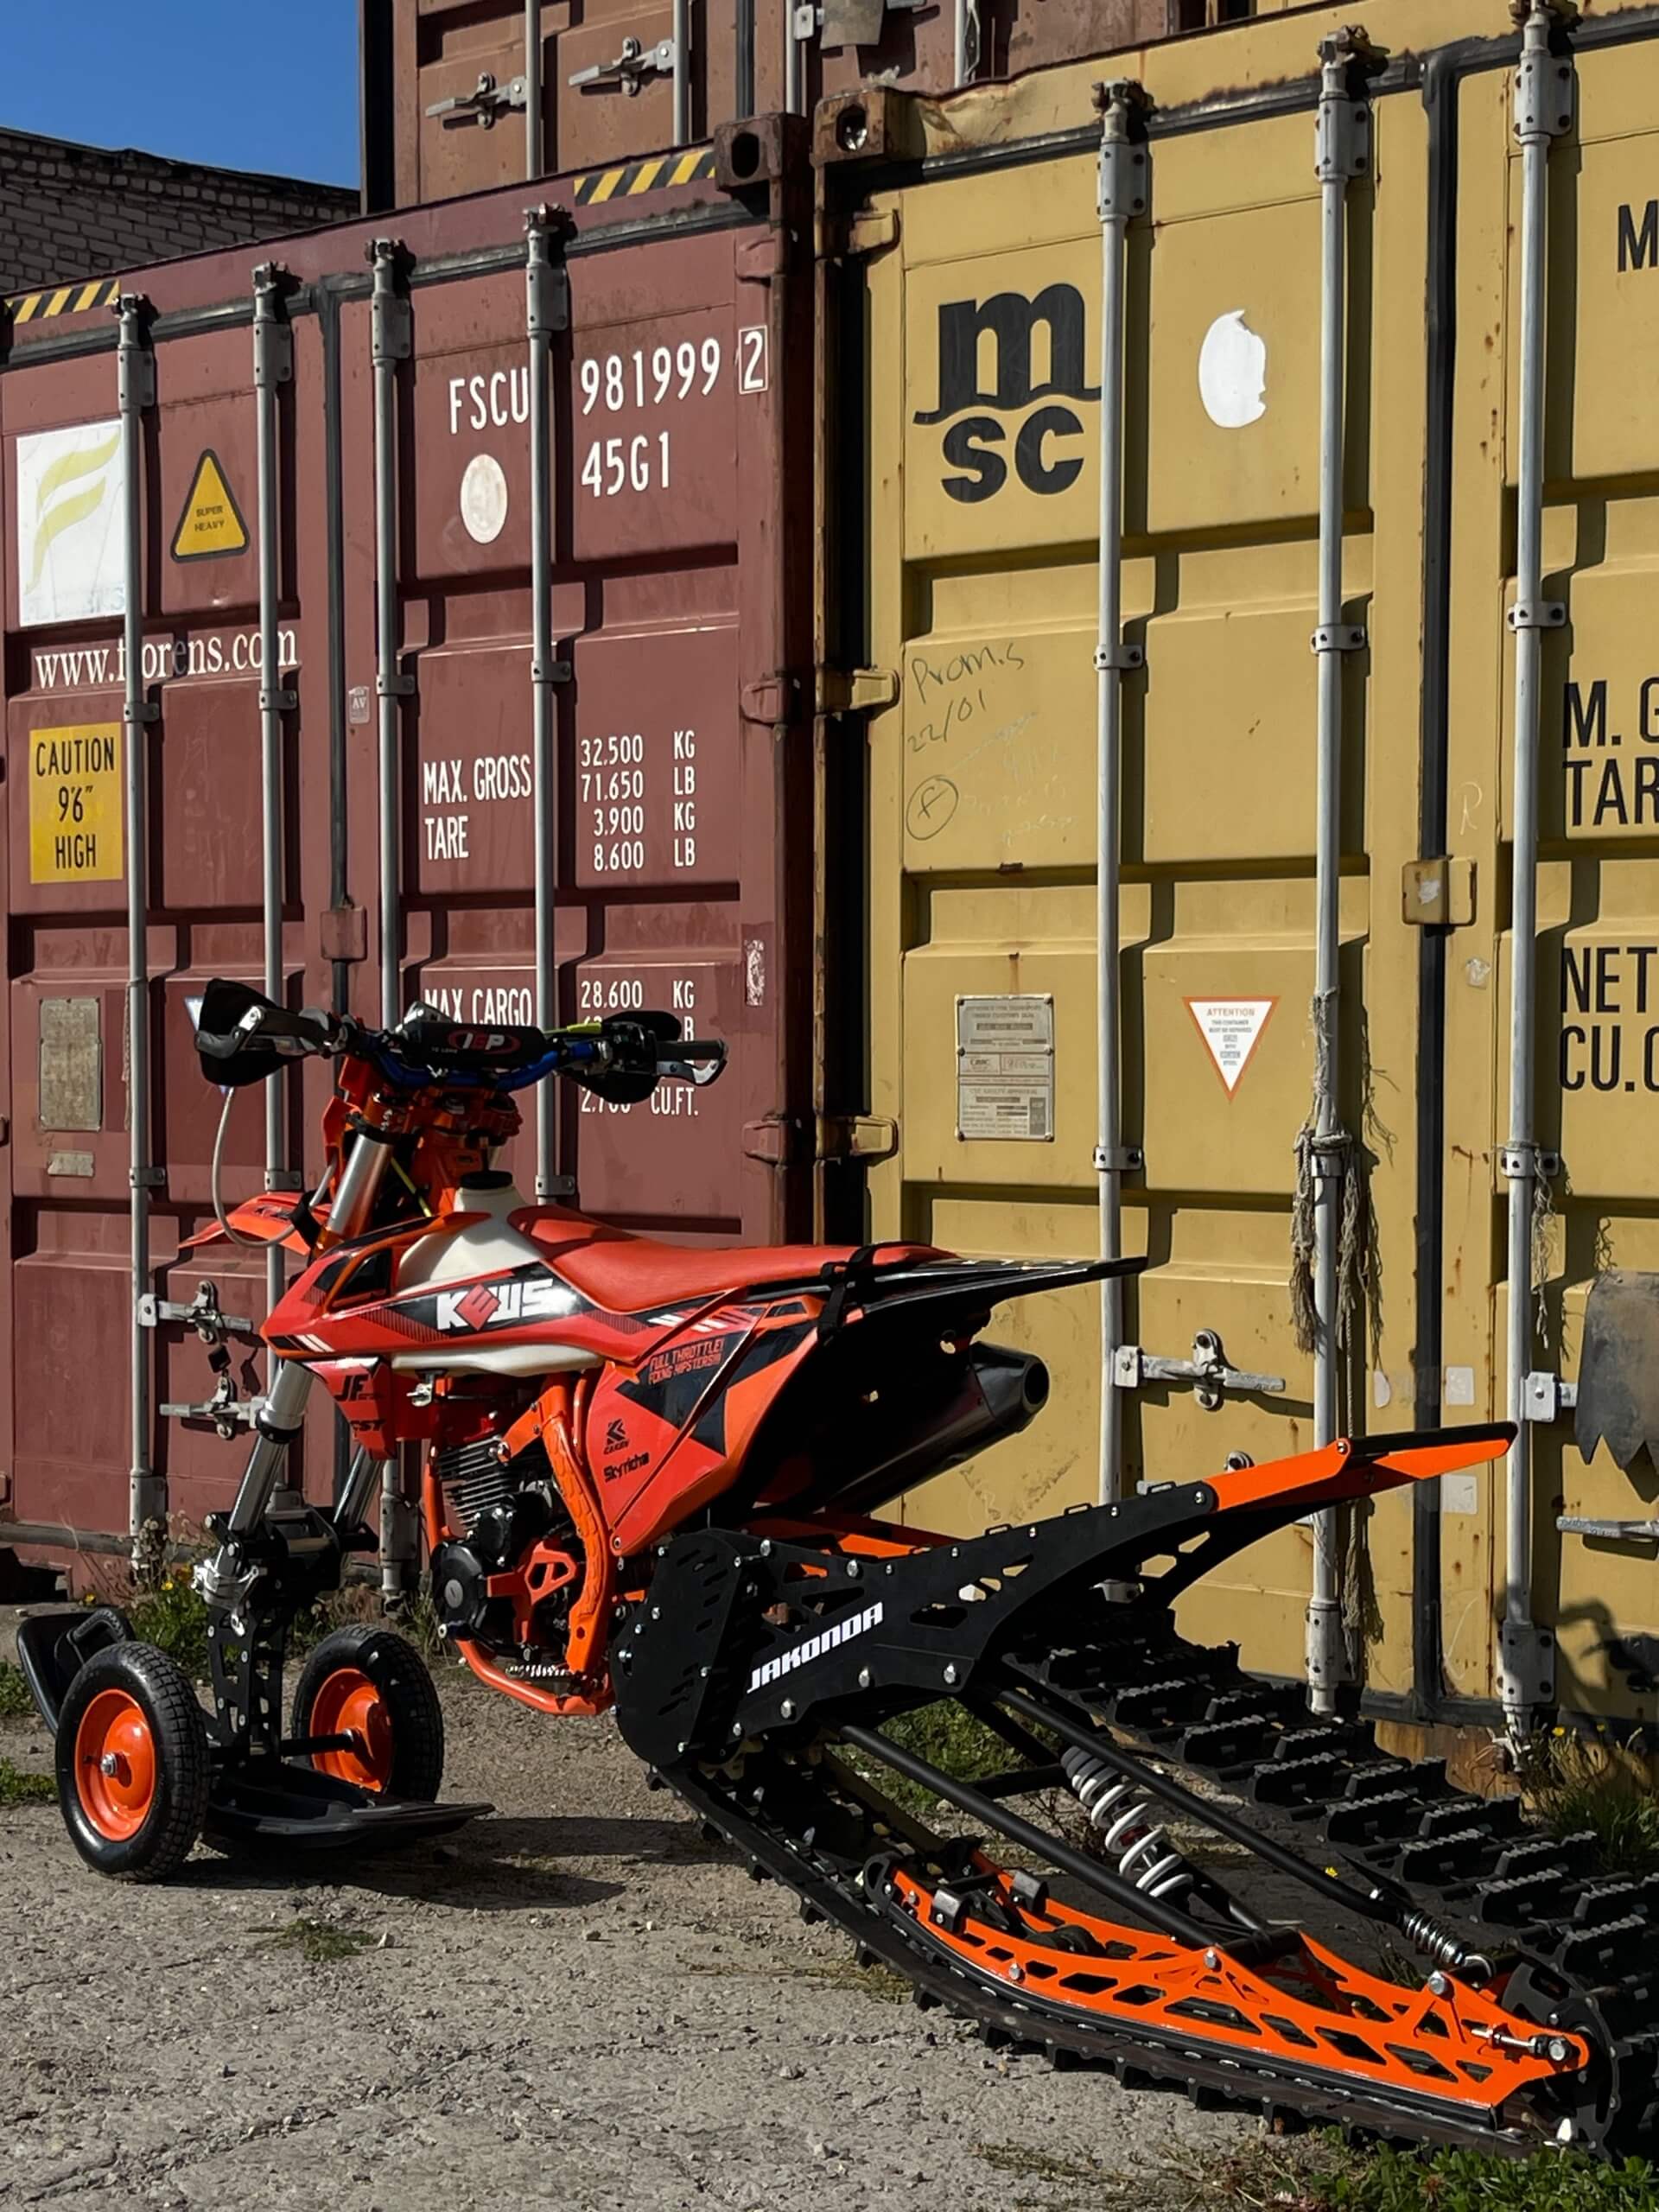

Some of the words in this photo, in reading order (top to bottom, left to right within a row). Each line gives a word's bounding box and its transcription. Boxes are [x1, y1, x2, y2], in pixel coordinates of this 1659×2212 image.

[1617, 199, 1658, 273] M
[448, 366, 530, 435] FSCU
[580, 338, 721, 416] 981999
[742, 329, 766, 391] 2
[581, 430, 670, 498] 45G1
[194, 520, 225, 531] HEAVY
[195, 505, 224, 518] SUPER
[35, 630, 299, 690] www.forens.com
[1562, 679, 1622, 748] M.
[35, 736, 115, 777] CAUTION
[580, 734, 644, 768] 32.500
[673, 730, 696, 760] KG
[423, 760, 468, 805] MAX.
[473, 754, 532, 803] GROSS
[581, 770, 644, 803] 71.650
[673, 766, 696, 796] LB
[1561, 756, 1659, 827] TAR
[424, 815, 470, 861] TARE
[593, 805, 645, 836] 3.900
[673, 801, 696, 832] KG
[55, 833, 97, 869] HIGH
[593, 840, 645, 872] 8.600
[673, 836, 696, 868] LB
[580, 980, 644, 1010] 28.600
[672, 980, 695, 1009] KG
[1560, 946, 1658, 1014] NET
[472, 988, 533, 1027] CARGO
[1206, 1007, 1255, 1017] ATTENTION
[650, 1085, 699, 1116] CU.FT.
[747, 1601, 884, 1694] JAKONDA
